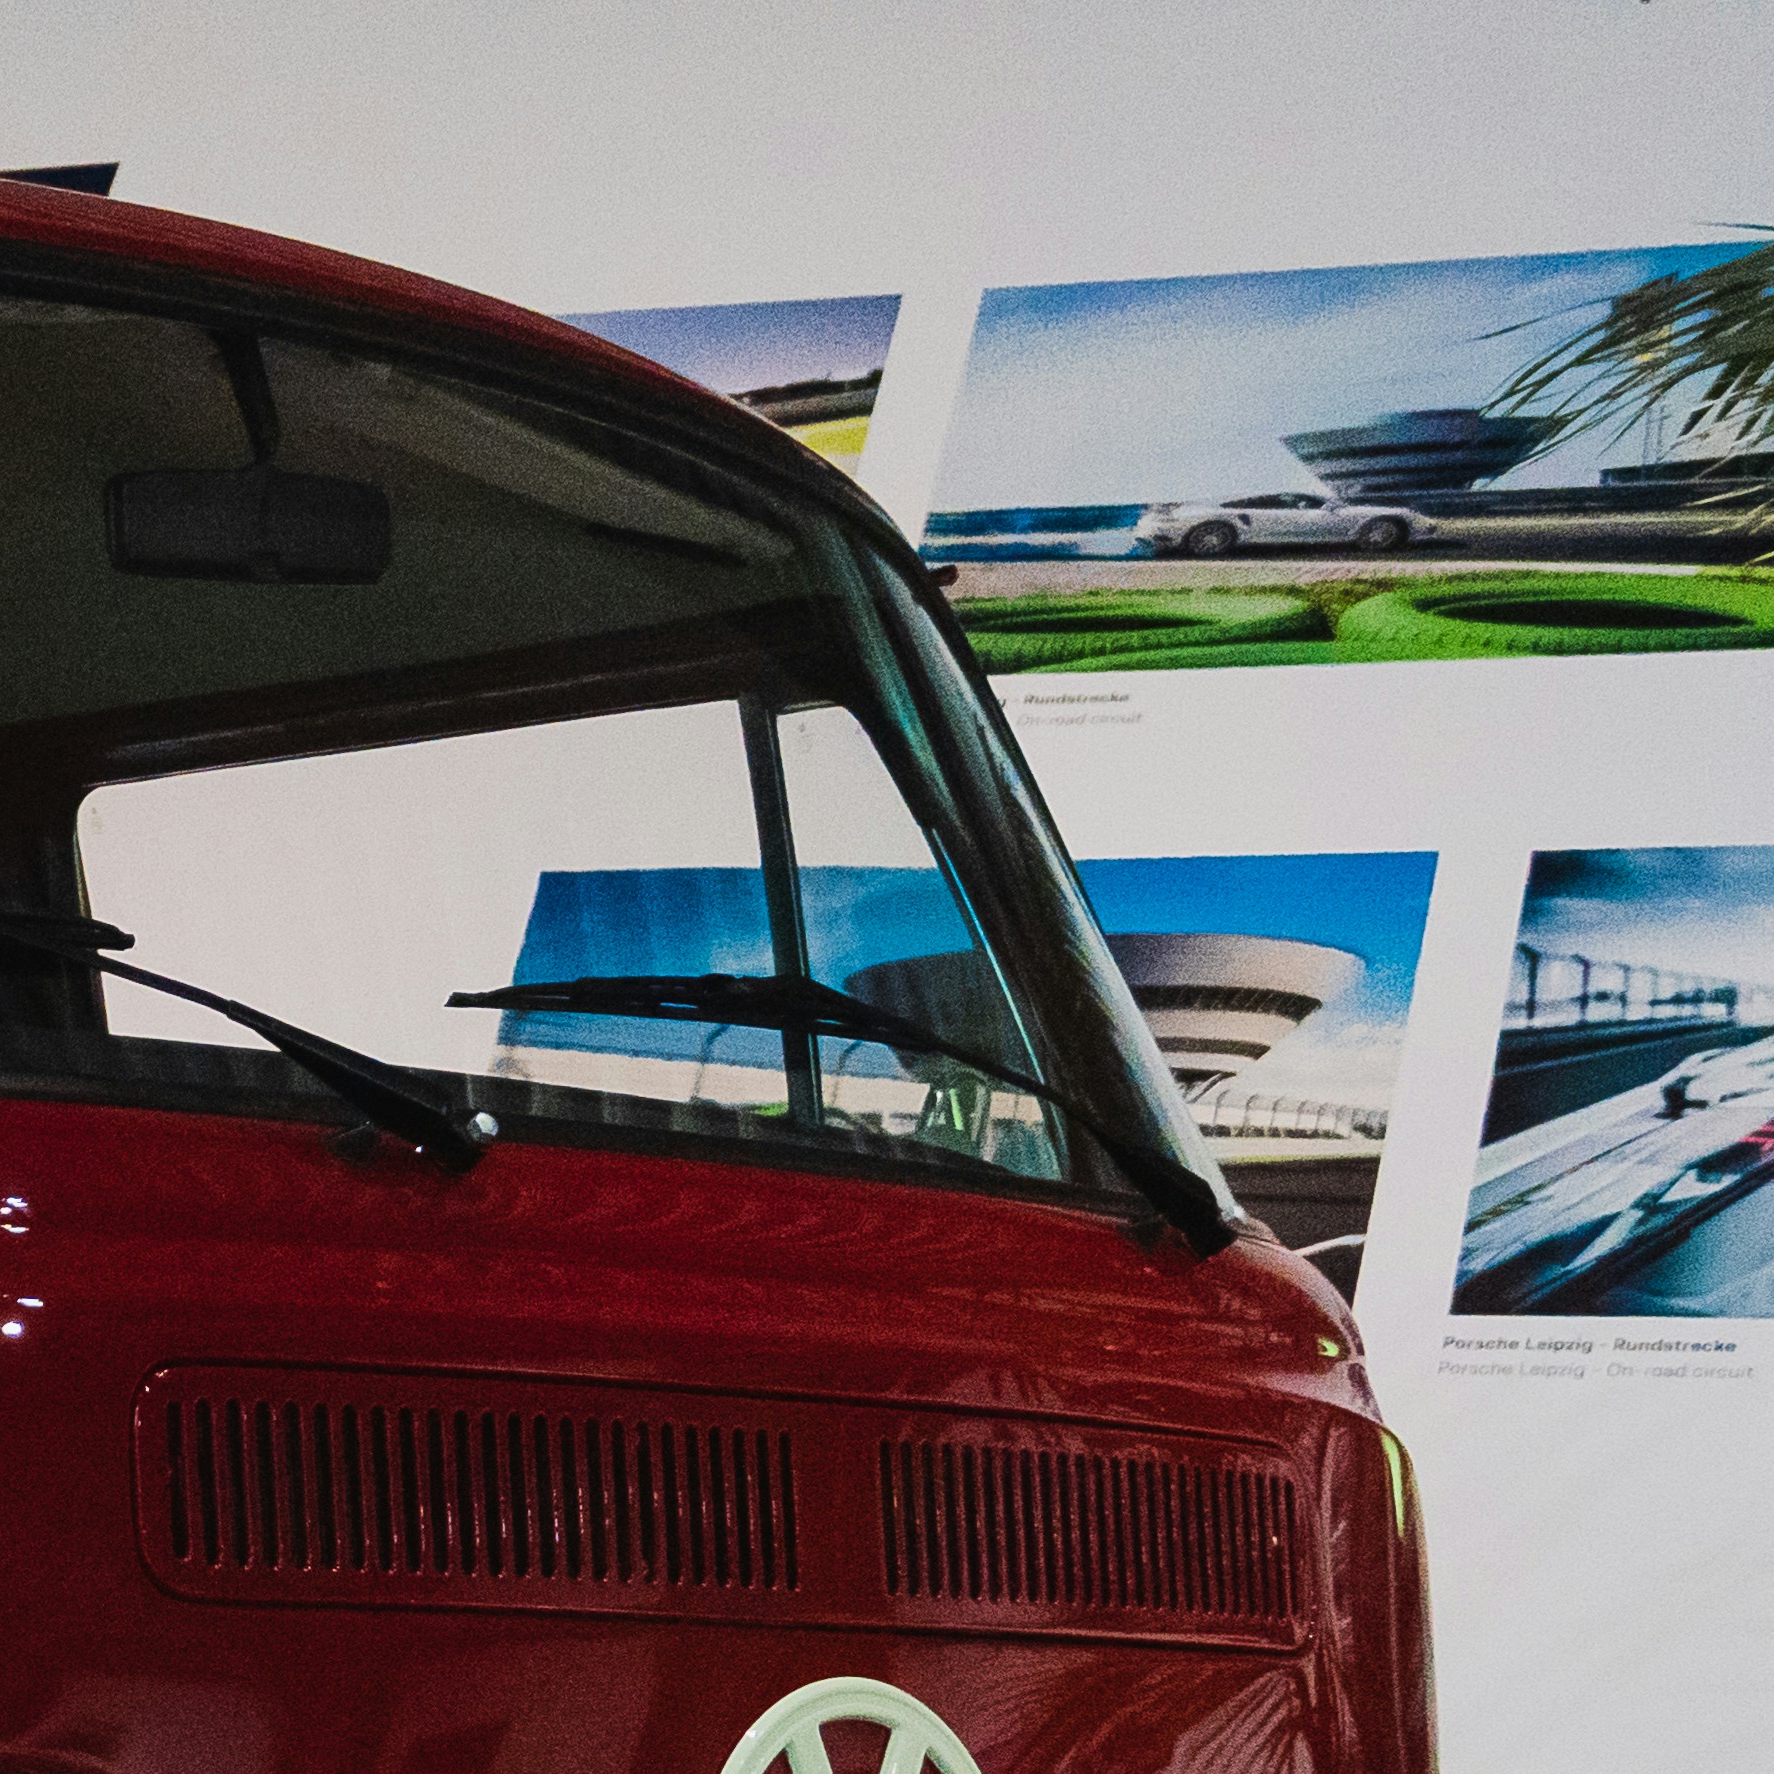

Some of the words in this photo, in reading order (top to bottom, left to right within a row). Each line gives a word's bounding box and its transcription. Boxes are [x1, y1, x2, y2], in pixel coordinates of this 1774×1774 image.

[1441, 1336, 1520, 1349] Porsche
[1525, 1337, 1594, 1355] Leipzig
[1612, 1337, 1738, 1351] Rundstrecke
